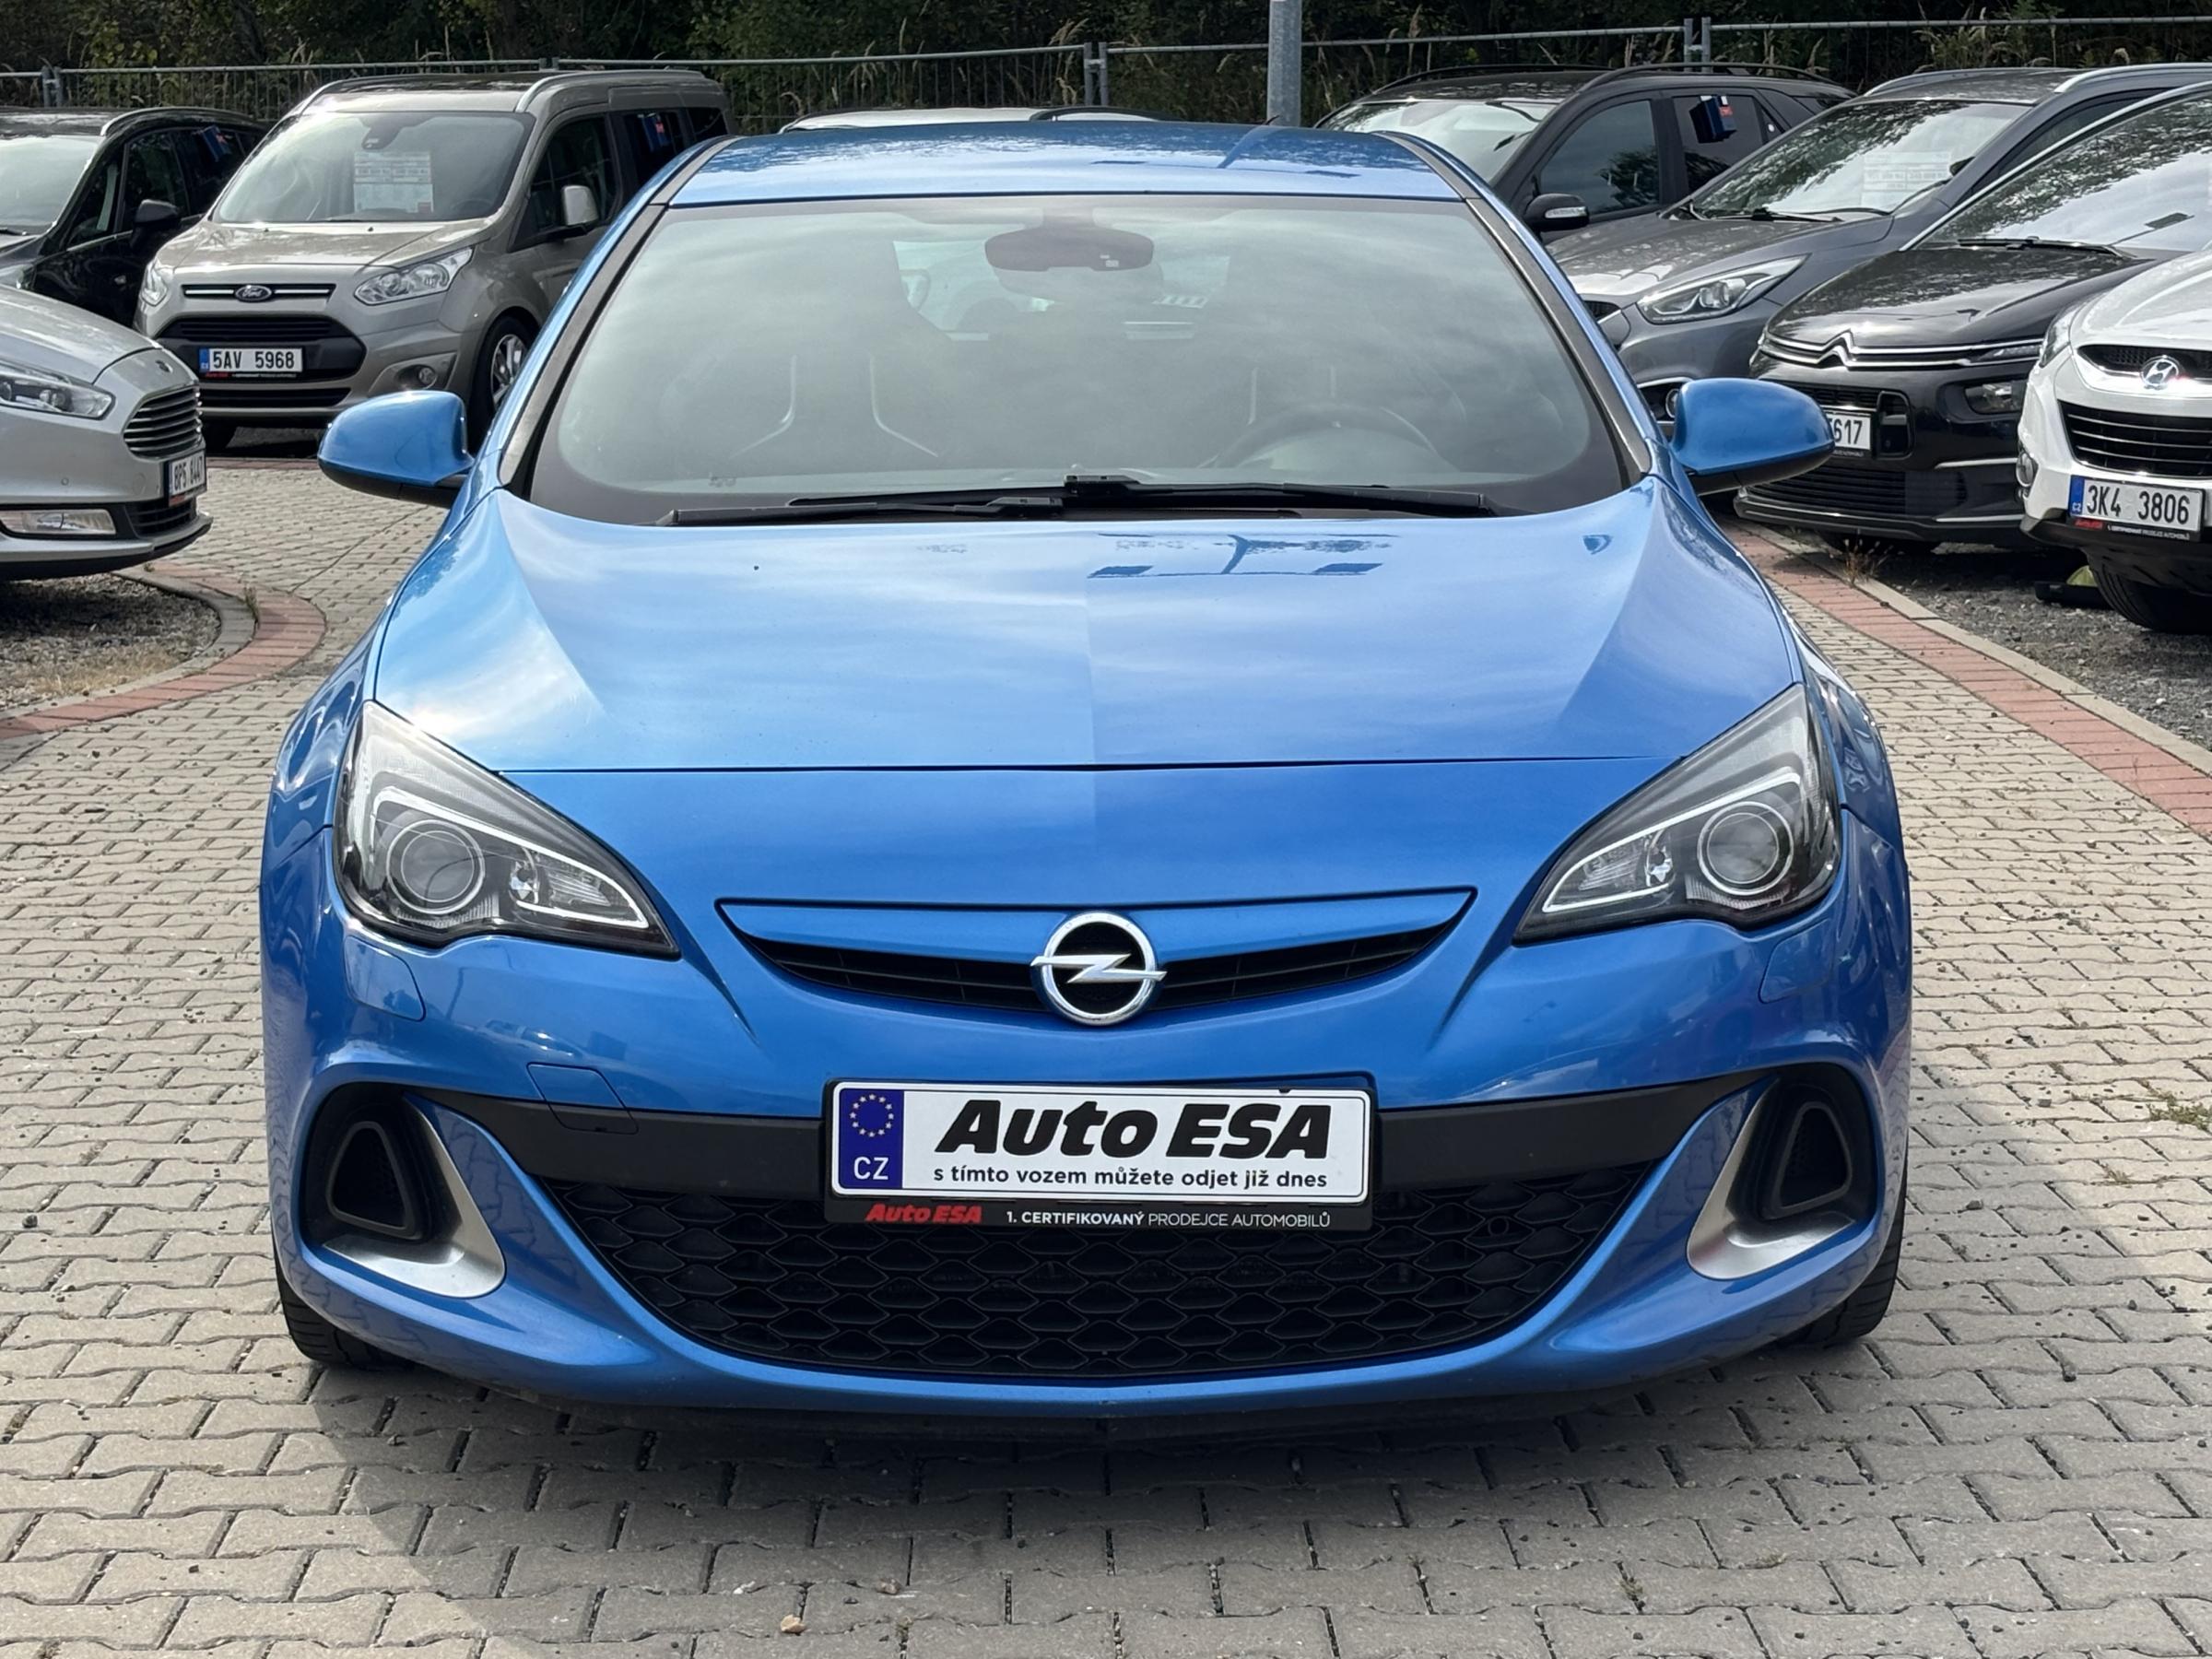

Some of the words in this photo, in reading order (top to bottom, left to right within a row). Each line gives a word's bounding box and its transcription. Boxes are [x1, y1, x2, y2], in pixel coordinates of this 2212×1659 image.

[213, 351, 242, 369] 5AV
[254, 351, 295, 369] 5968
[1828, 418, 1863, 444] 617
[2087, 485, 2121, 517] 3K4
[2138, 490, 2190, 524] 3806
[934, 1099, 1159, 1158] Auto
[1166, 1103, 1332, 1159] ESA
[853, 1156, 888, 1181] CZ
[934, 1168, 944, 1181] s
[951, 1165, 1009, 1182] tímto
[1017, 1170, 1086, 1183] vozem
[1095, 1166, 1174, 1185] můžete
[1182, 1170, 1238, 1189] odjet
[1244, 1170, 1269, 1190] již
[1277, 1171, 1327, 1187] dnes
[865, 1203, 931, 1223] Auto
[933, 1205, 982, 1223] ESA
[1006, 1211, 1017, 1223] 1.
[1021, 1210, 1145, 1225] CERTIFIKOVANÝ
[1148, 1213, 1228, 1226] PRODEJCE
[1231, 1211, 1330, 1227] AUTOMOBILŮ
